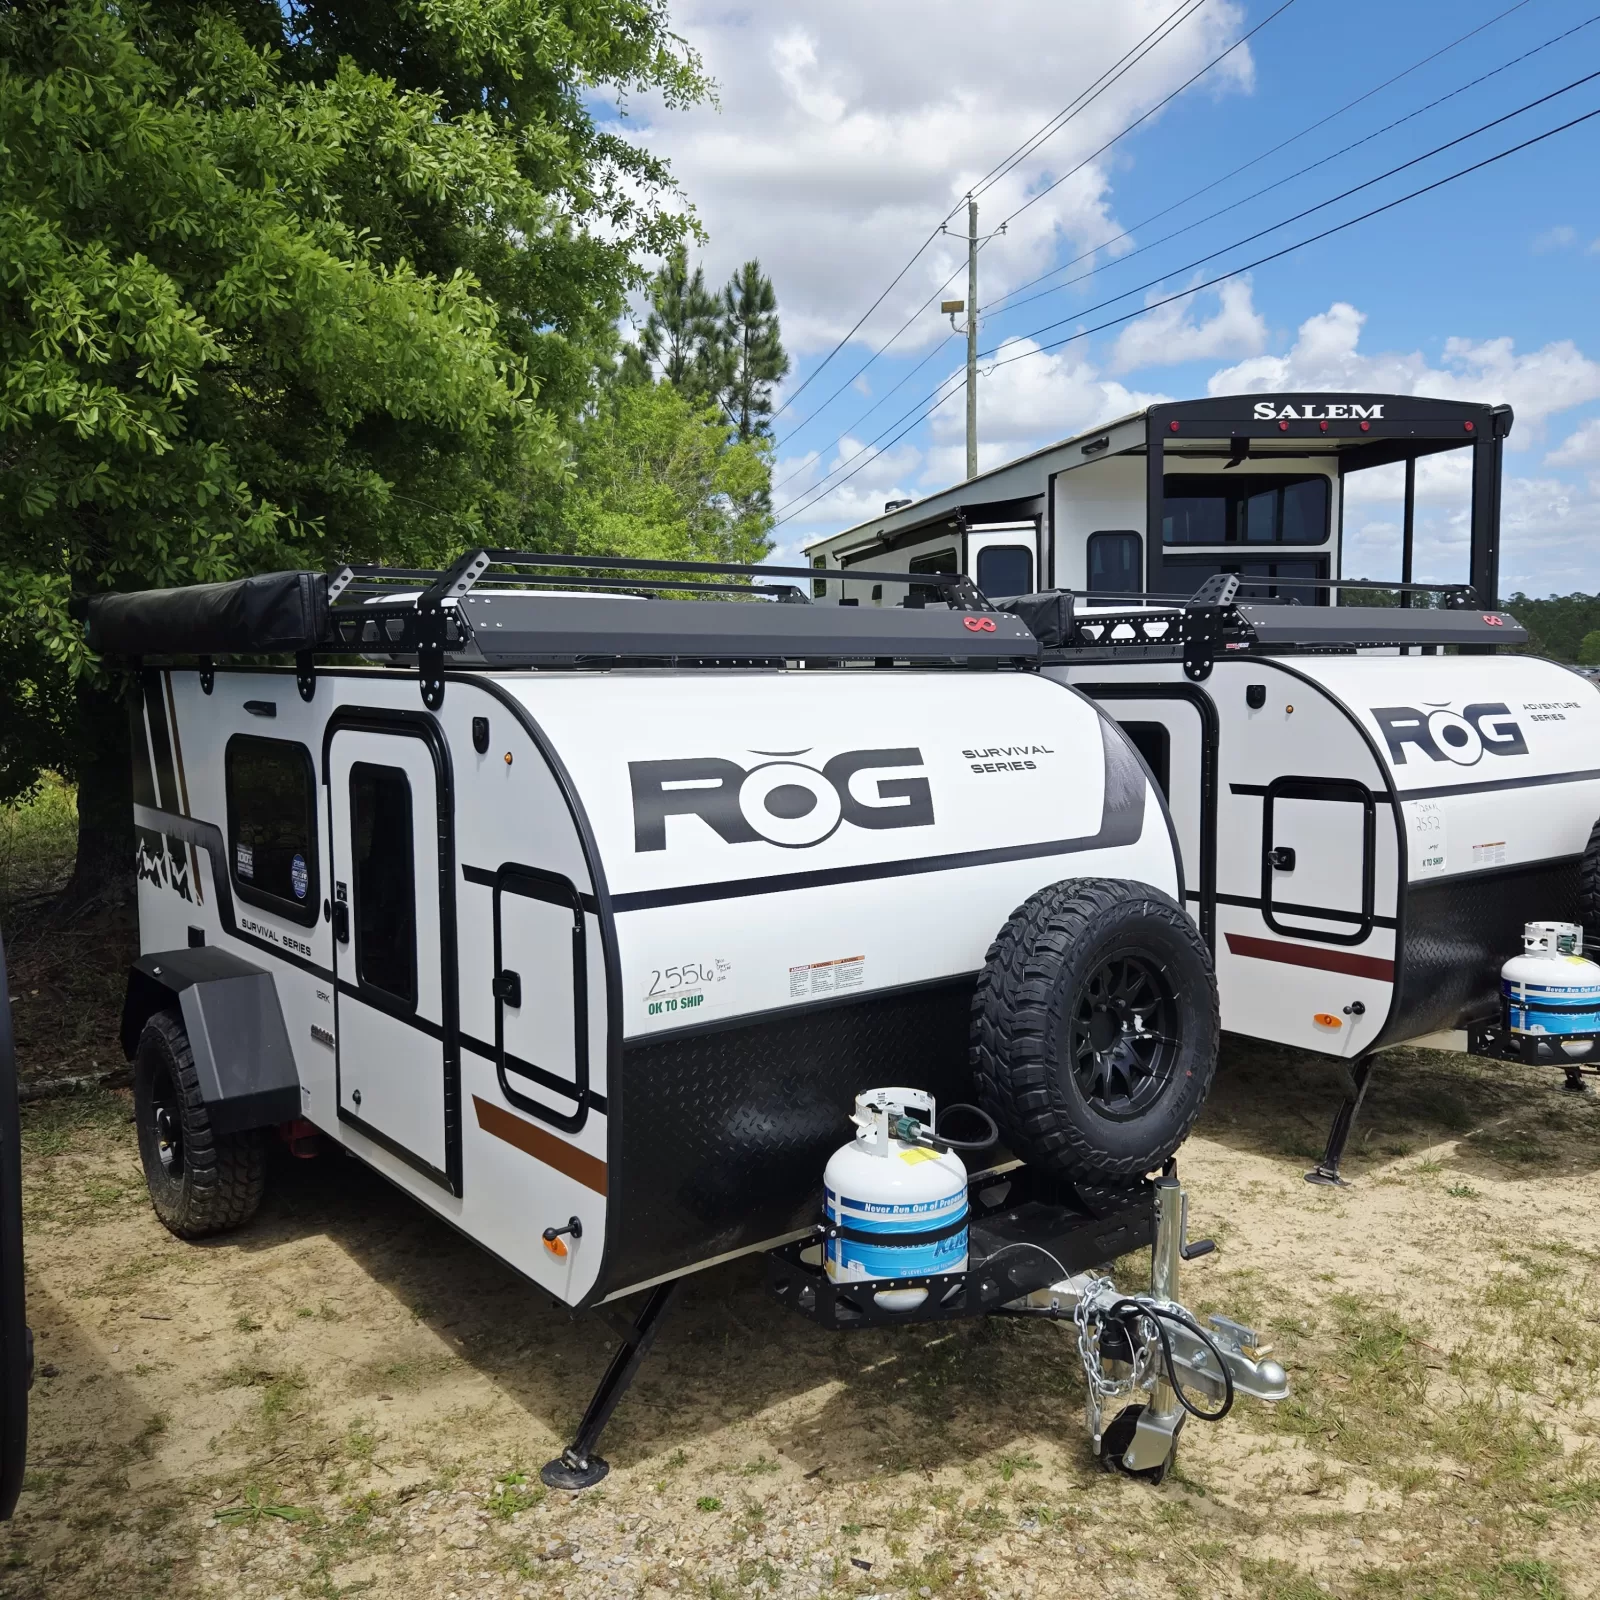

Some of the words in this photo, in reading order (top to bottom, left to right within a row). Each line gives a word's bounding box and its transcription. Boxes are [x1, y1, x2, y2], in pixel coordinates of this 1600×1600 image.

[1254, 402, 1385, 419] SALEM
[1523, 702, 1582, 711] ADVENTURE
[1530, 713, 1566, 721] SERIES
[1369, 701, 1530, 767] ROG
[961, 745, 1055, 759] SURVIVAL
[970, 760, 1037, 774] SERIES
[628, 747, 935, 853] ROG
[1416, 816, 1441, 832] 2552
[1433, 857, 1444, 866] SHIP
[241, 918, 279, 943] SURVIVAL
[282, 935, 312, 957] SERIES
[648, 963, 714, 996] 2556
[648, 1001, 663, 1016] OK
[665, 999, 678, 1012] TO
[680, 994, 704, 1009] SHIP
[865, 1203, 890, 1213] Never
[893, 1205, 910, 1214] Run
[913, 1204, 928, 1213] Out
[929, 1200, 938, 1211] of
[940, 1194, 963, 1208] Propane
[908, 1268, 923, 1276] LEVEL
